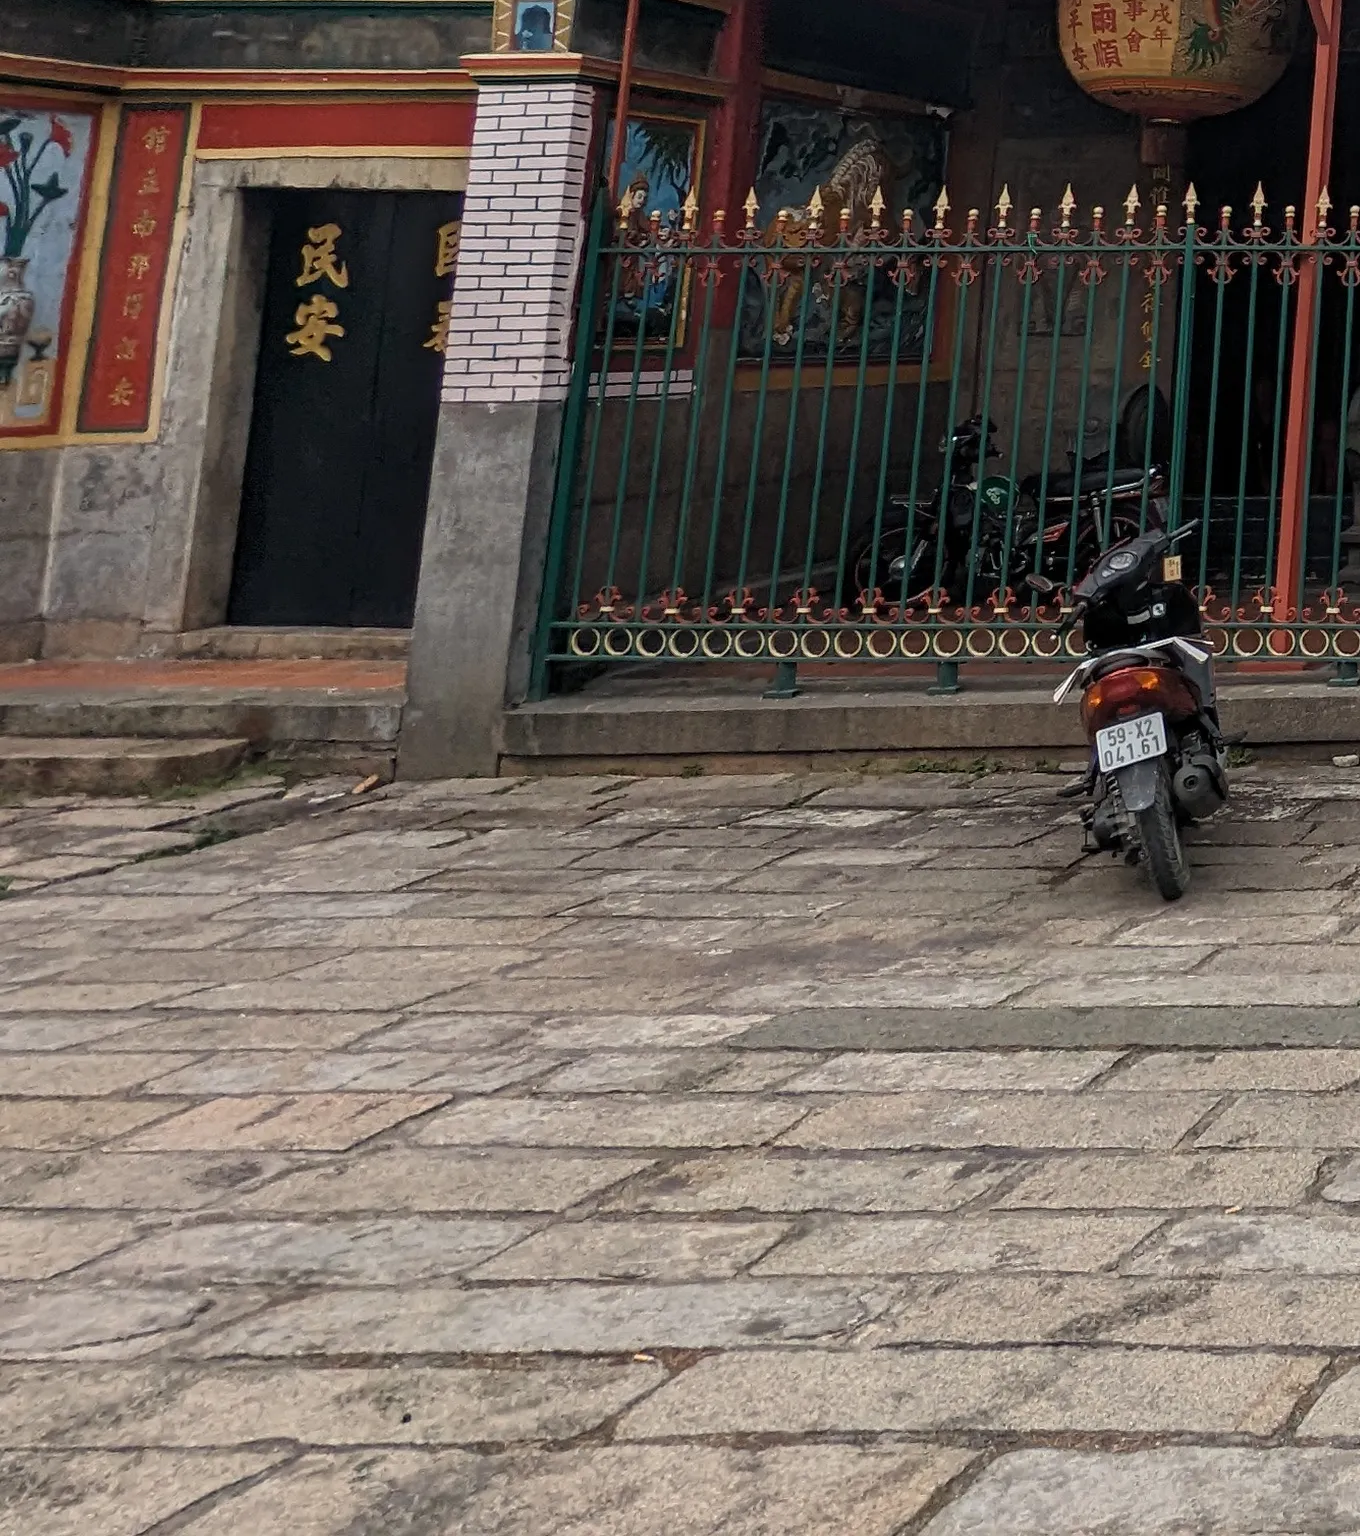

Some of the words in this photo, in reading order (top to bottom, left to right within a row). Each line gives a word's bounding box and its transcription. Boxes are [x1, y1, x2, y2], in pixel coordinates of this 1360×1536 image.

[286, 222, 349, 362] 民安
[1107, 719, 1155, 747] 59-X2
[1104, 735, 1160, 767] 041.61
